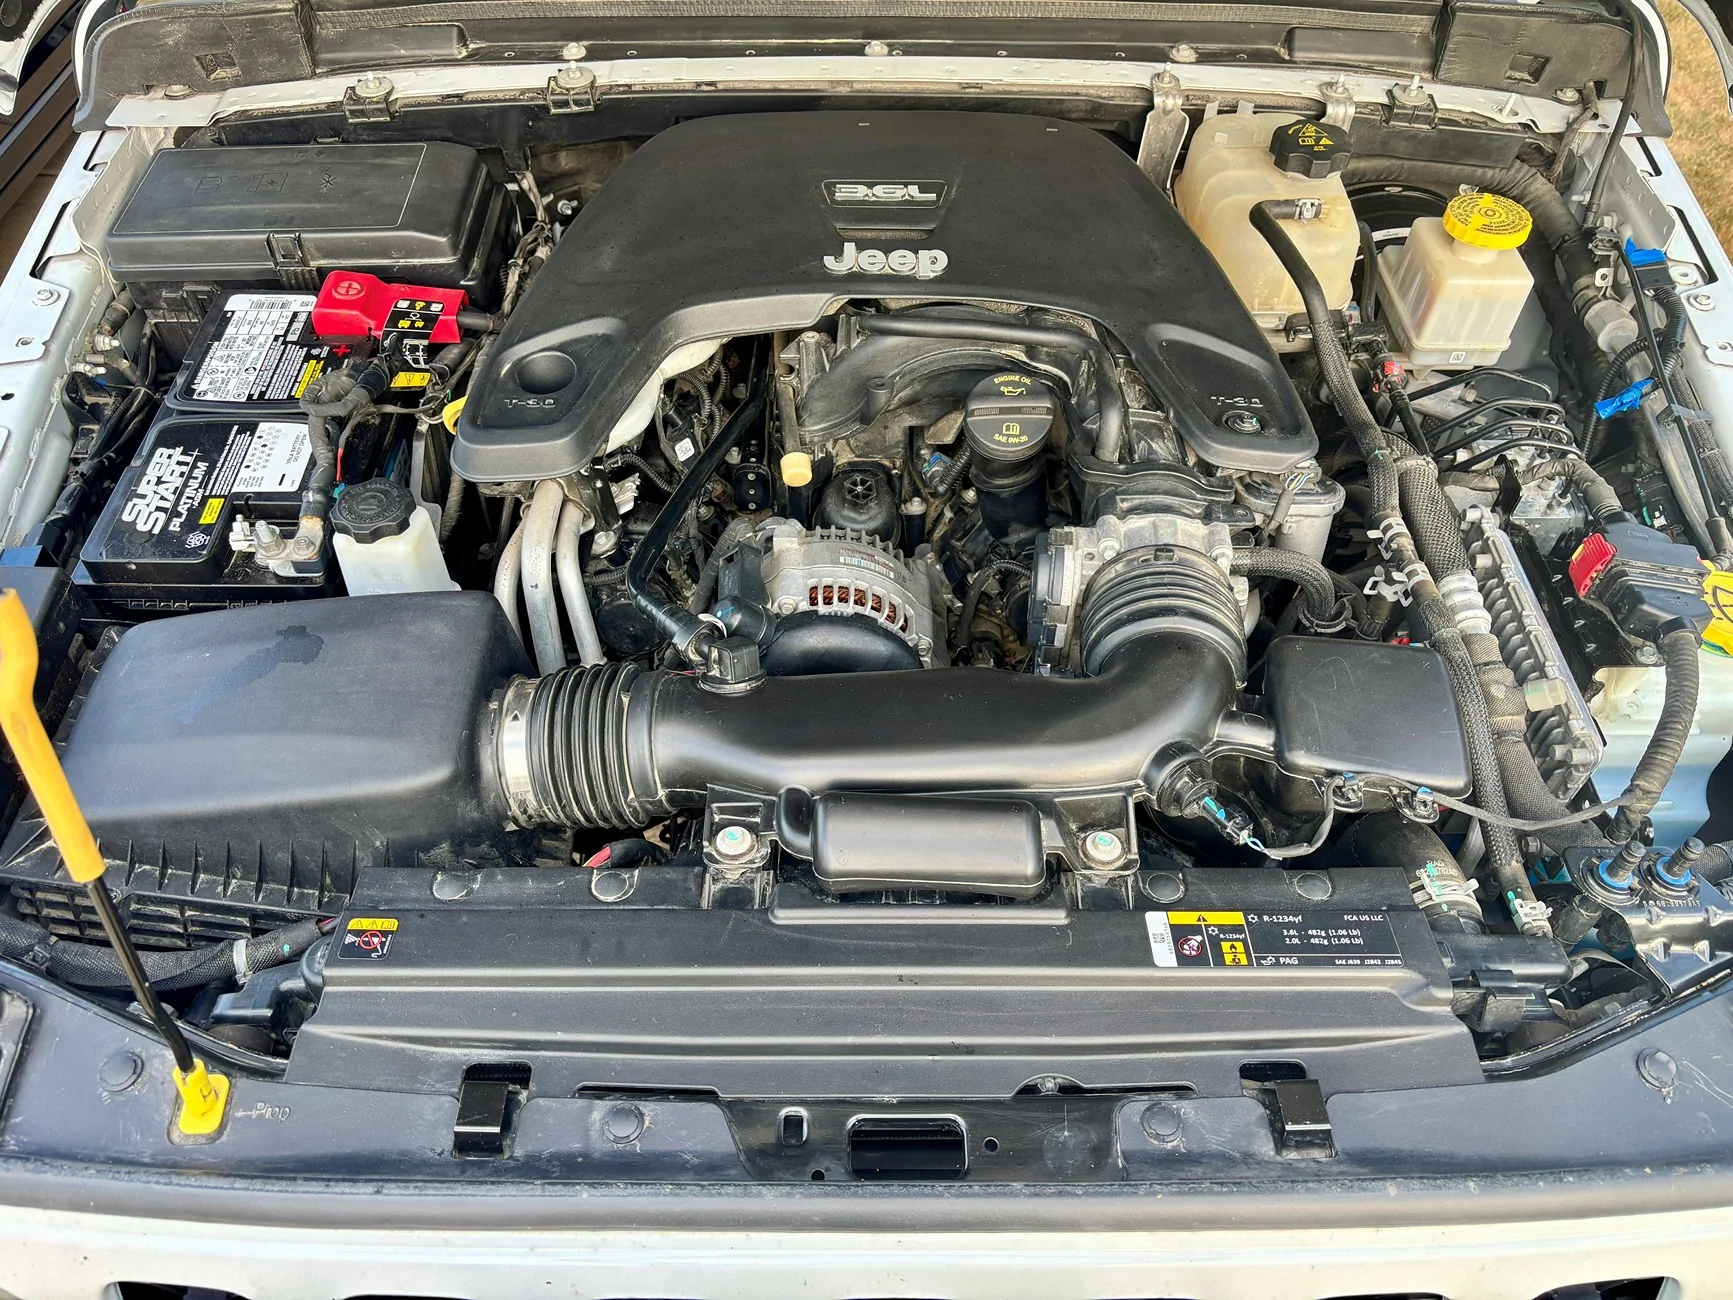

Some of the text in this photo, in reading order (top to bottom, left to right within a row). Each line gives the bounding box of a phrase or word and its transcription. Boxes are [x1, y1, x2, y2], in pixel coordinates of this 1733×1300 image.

[823, 242, 949, 280] Jeep
[994, 375, 1032, 385] ENGINE OIL
[993, 433, 1028, 444] SAE 0W-20
[121, 447, 176, 522] SUPER
[135, 446, 193, 534] START
[168, 462, 209, 531] PLATINUM
[1263, 915, 1303, 924] R-1234yf
[1308, 929, 1326, 937] 482g
[1329, 928, 1347, 937] (1.06
[1331, 937, 1350, 945] (1.06
[1280, 957, 1298, 965] PAG
[252, 1101, 291, 1123] Prop
